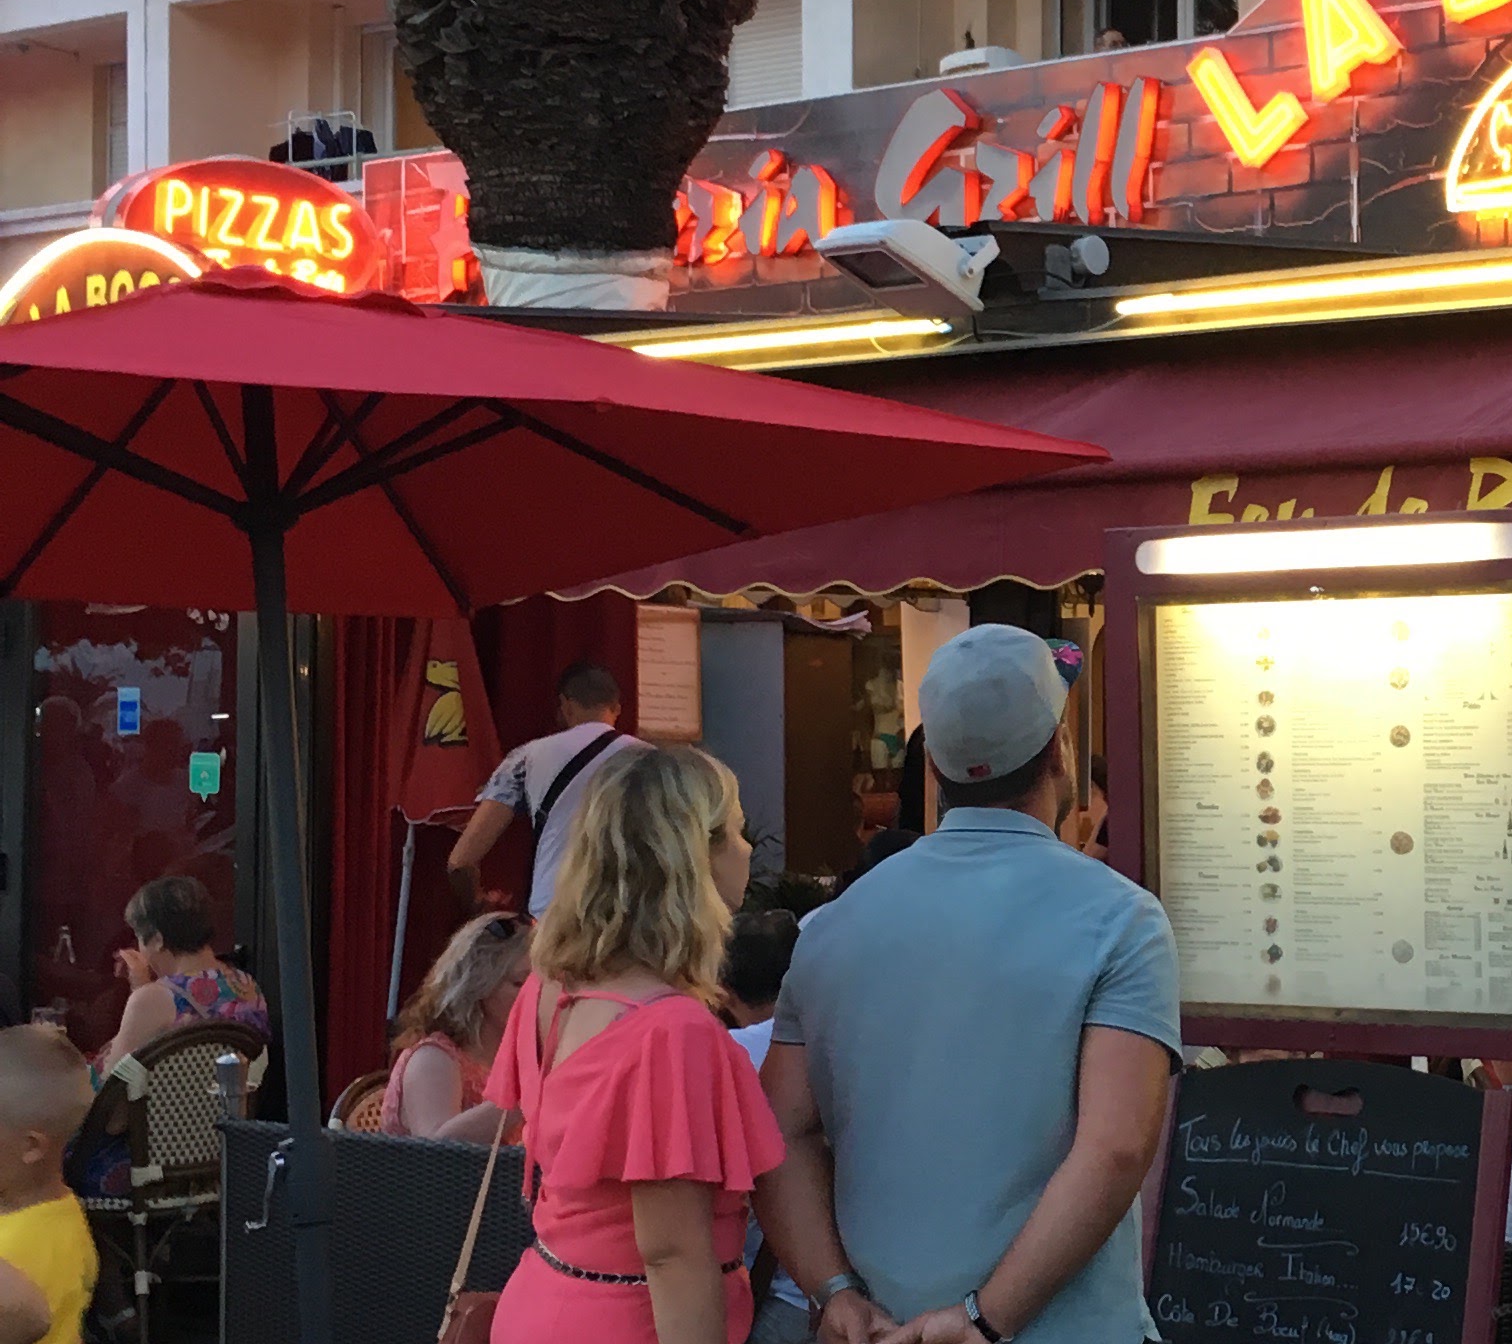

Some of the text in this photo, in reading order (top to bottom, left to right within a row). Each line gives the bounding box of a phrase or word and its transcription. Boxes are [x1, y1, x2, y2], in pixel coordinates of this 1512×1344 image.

[874, 76, 1163, 226] Grill
[154, 178, 354, 260] PIZZAS
[1179, 1114, 1222, 1154] Tous
[1230, 1117, 1251, 1149] les
[1251, 1134, 1298, 1165] jours
[1327, 1126, 1369, 1176] Chef
[1374, 1139, 1408, 1157] vous
[1411, 1139, 1471, 1170] propose
[1175, 1175, 1458, 1252] Salade Normande 15€90
[1157, 1294, 1196, 1324] Côte
[1205, 1300, 1239, 1328] De
